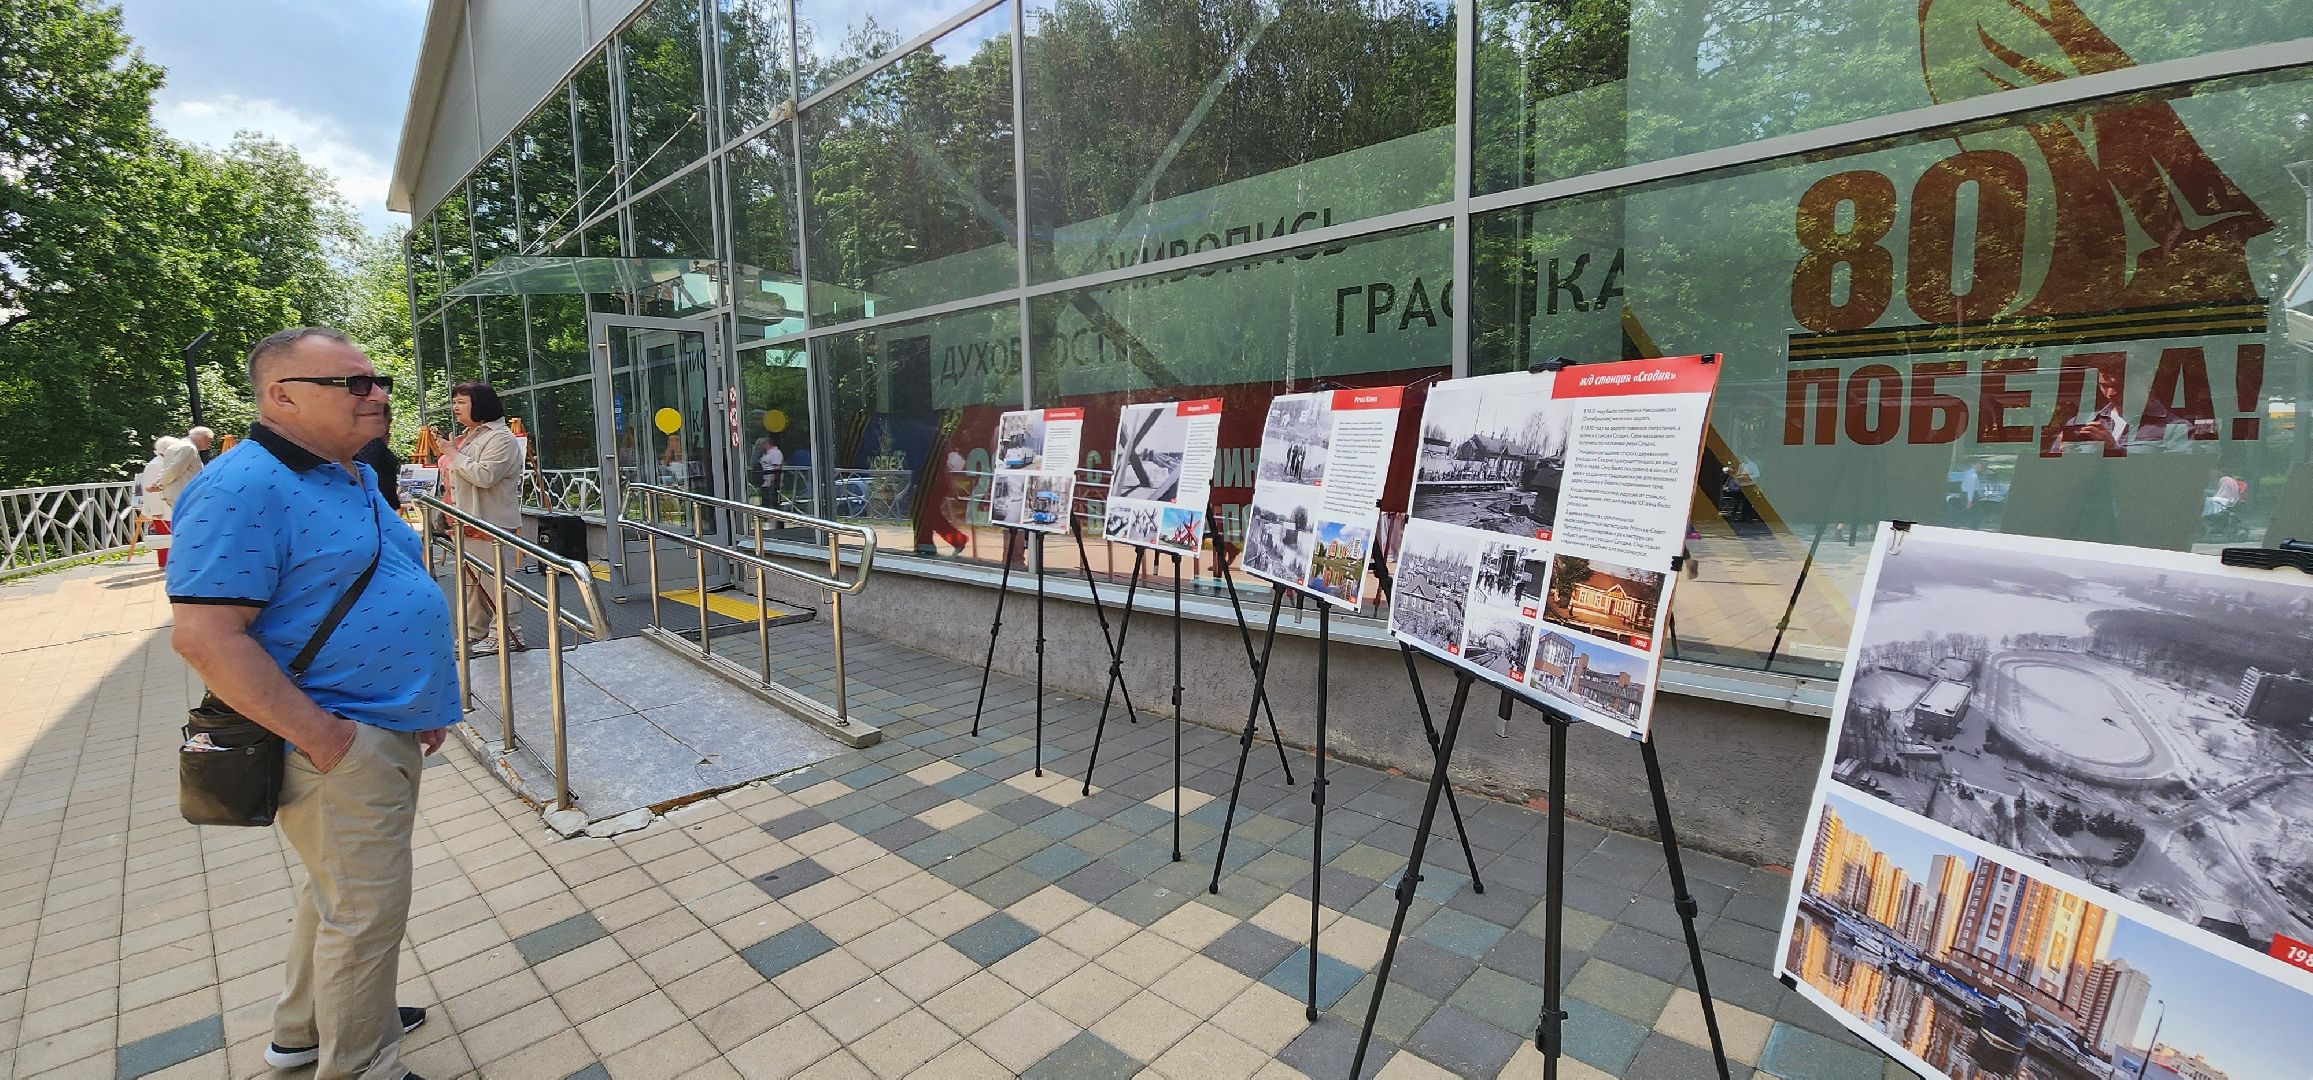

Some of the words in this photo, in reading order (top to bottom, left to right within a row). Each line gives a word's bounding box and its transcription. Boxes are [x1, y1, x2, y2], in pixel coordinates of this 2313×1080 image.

[1791, 149, 2029, 333] 80
[1335, 248, 1624, 336] ГРАКА
[1594, 374, 1631, 386] станция
[1633, 370, 1677, 382] «Сходня»
[1783, 344, 2265, 457] ПОБЕДА!
